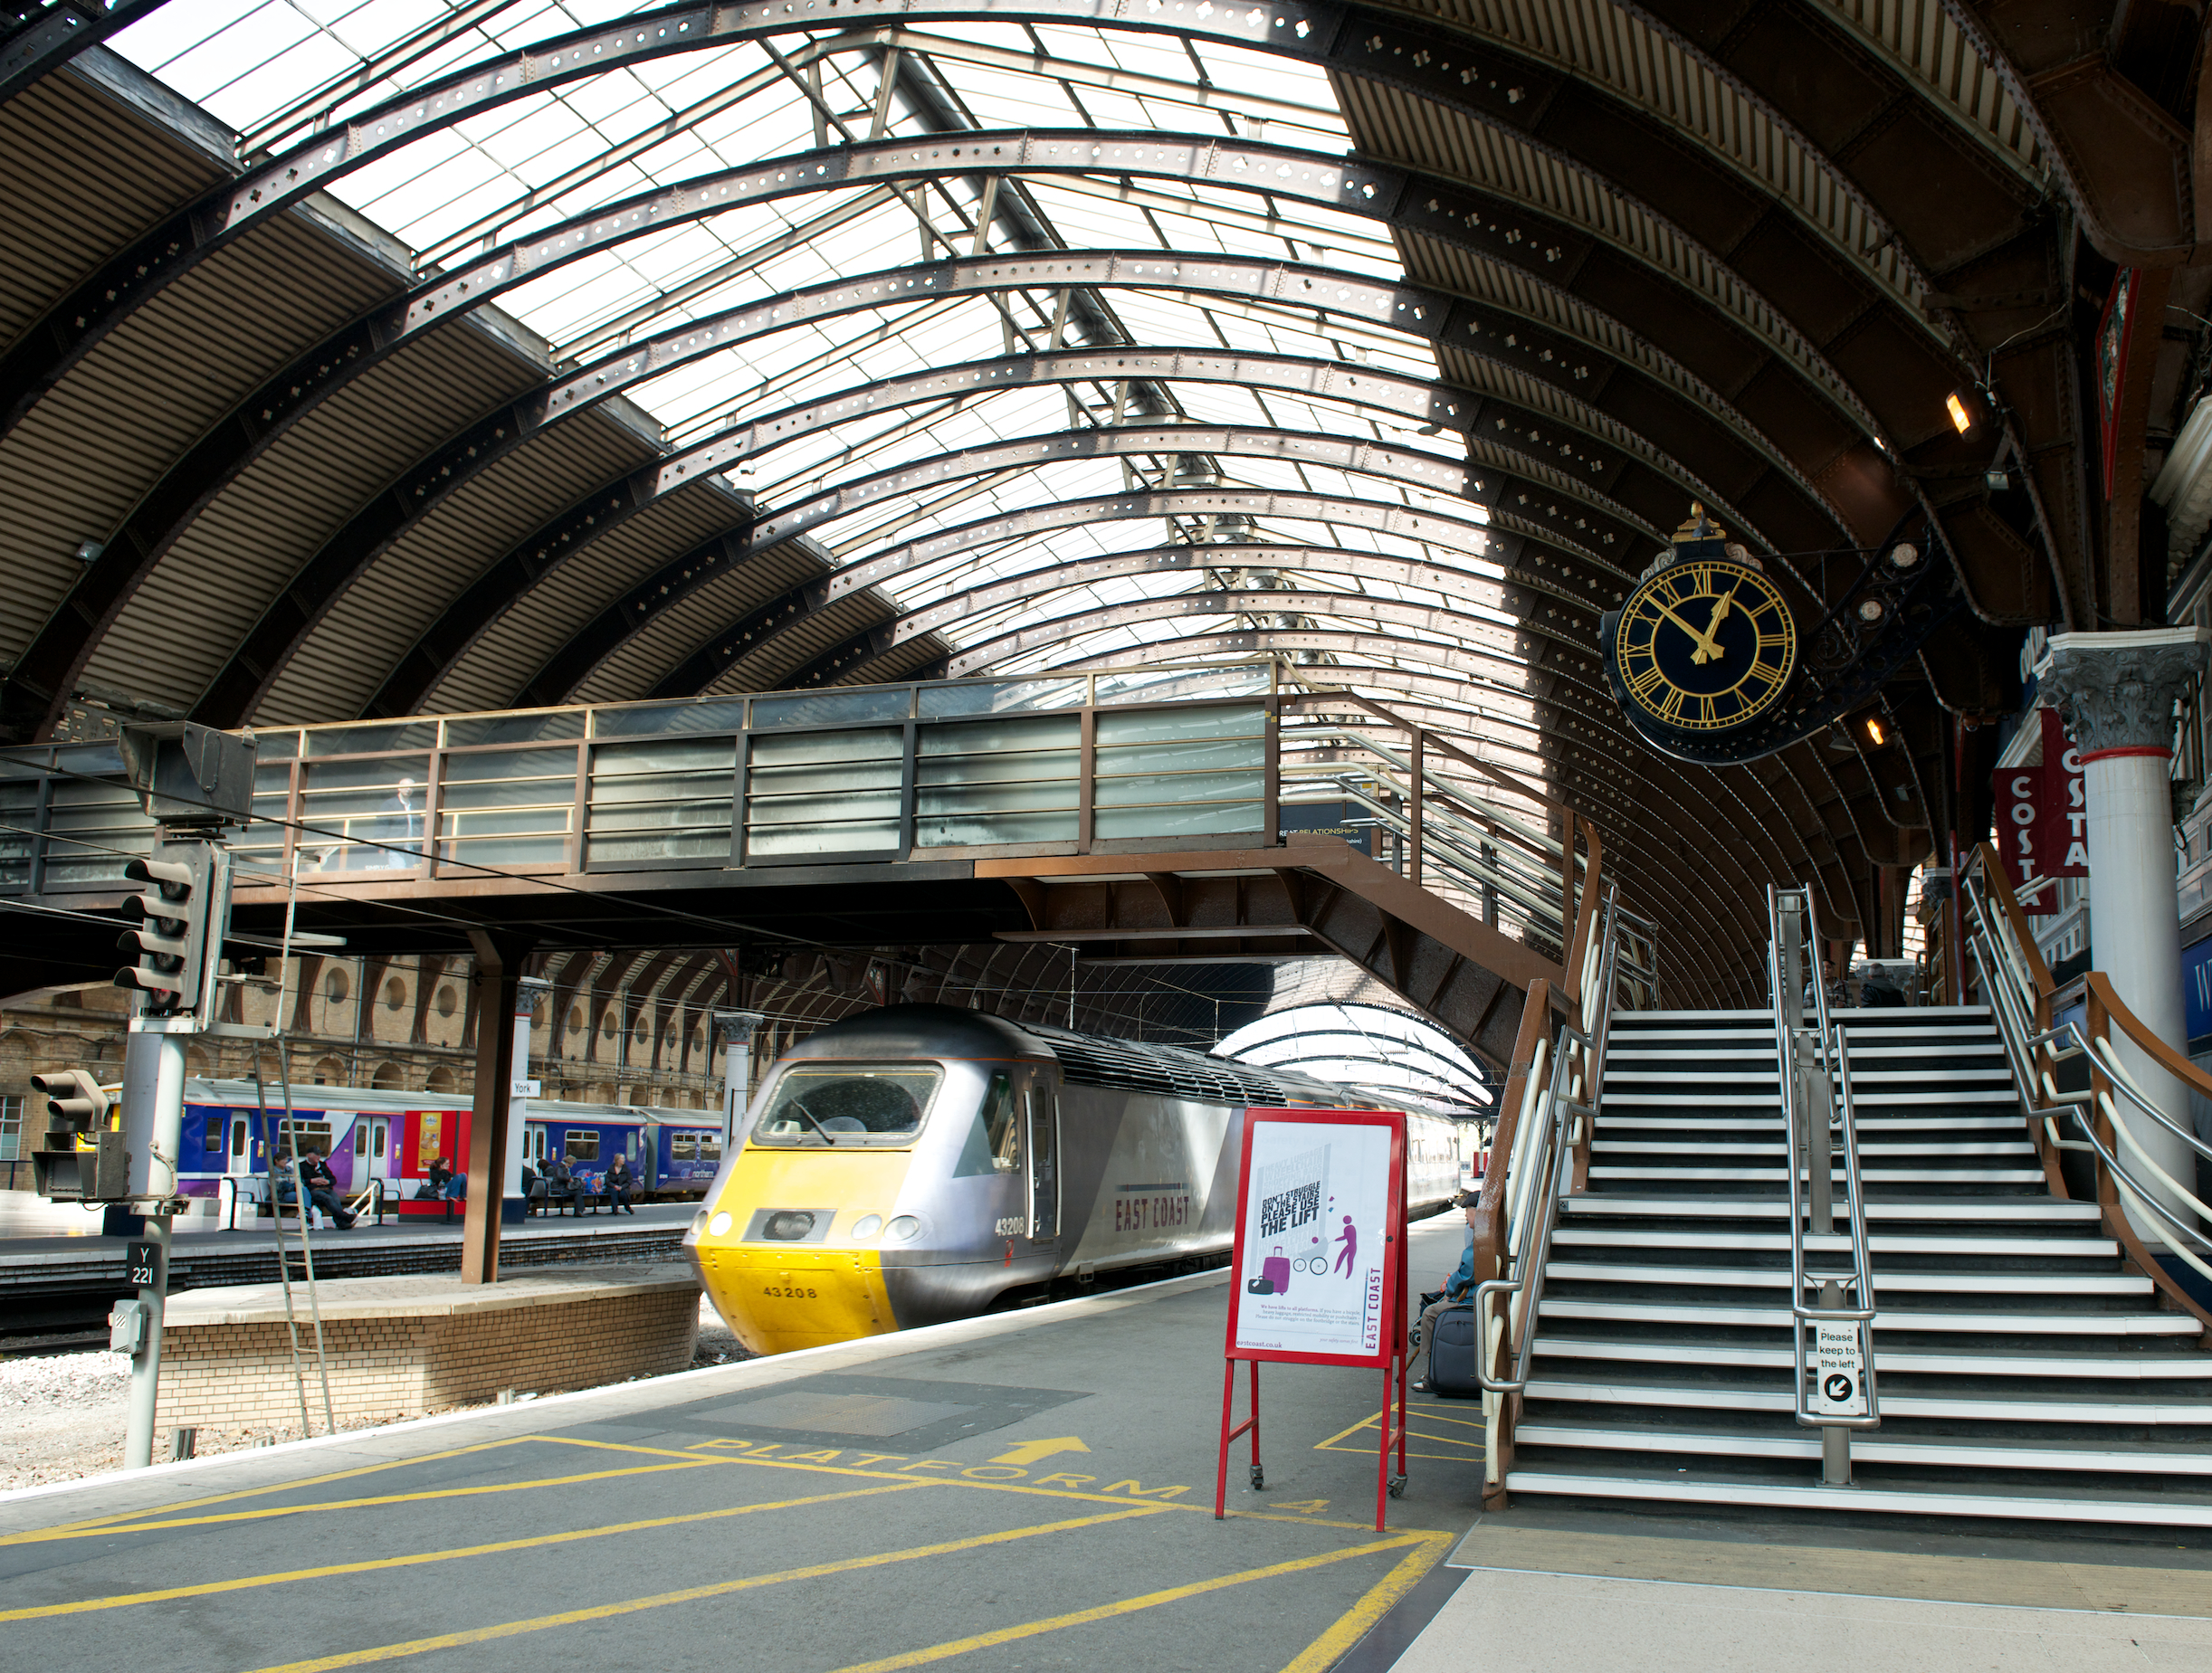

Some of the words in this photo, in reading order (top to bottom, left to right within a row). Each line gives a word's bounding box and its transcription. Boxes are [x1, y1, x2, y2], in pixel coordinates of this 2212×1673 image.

[514, 1083, 531, 1093] York
[1262, 1203, 1273, 1213] ON
[1276, 1197, 1290, 1212] THE
[1292, 1188, 1319, 1205] STAIRS
[1263, 1193, 1283, 1207] DON'T
[1285, 1181, 1321, 1200] STRUGGLE
[1115, 1199, 1148, 1231] EAST
[1153, 1196, 1189, 1228] COAST
[1261, 1204, 1296, 1224] PLEASE
[1300, 1195, 1319, 1211] USE
[995, 1216, 1025, 1236] 43208
[1260, 1217, 1287, 1239] THE
[1292, 1205, 1319, 1229] LIFT
[140, 1248, 149, 1263] Y
[132, 1267, 153, 1284] 221
[763, 1287, 817, 1298] 43208
[1368, 1268, 1381, 1309] COAST
[1365, 1317, 1378, 1349] EAST
[1820, 1333, 1854, 1342] Please
[1236, 1340, 1282, 1349] eastcoast.co.uk
[1819, 1345, 1844, 1356] keep
[1845, 1346, 1856, 1355] to
[1821, 1359, 1836, 1368] the
[1839, 1360, 1855, 1368] left
[684, 1438, 1192, 1498] PLATFORM
[1267, 1498, 1330, 1515] 4
